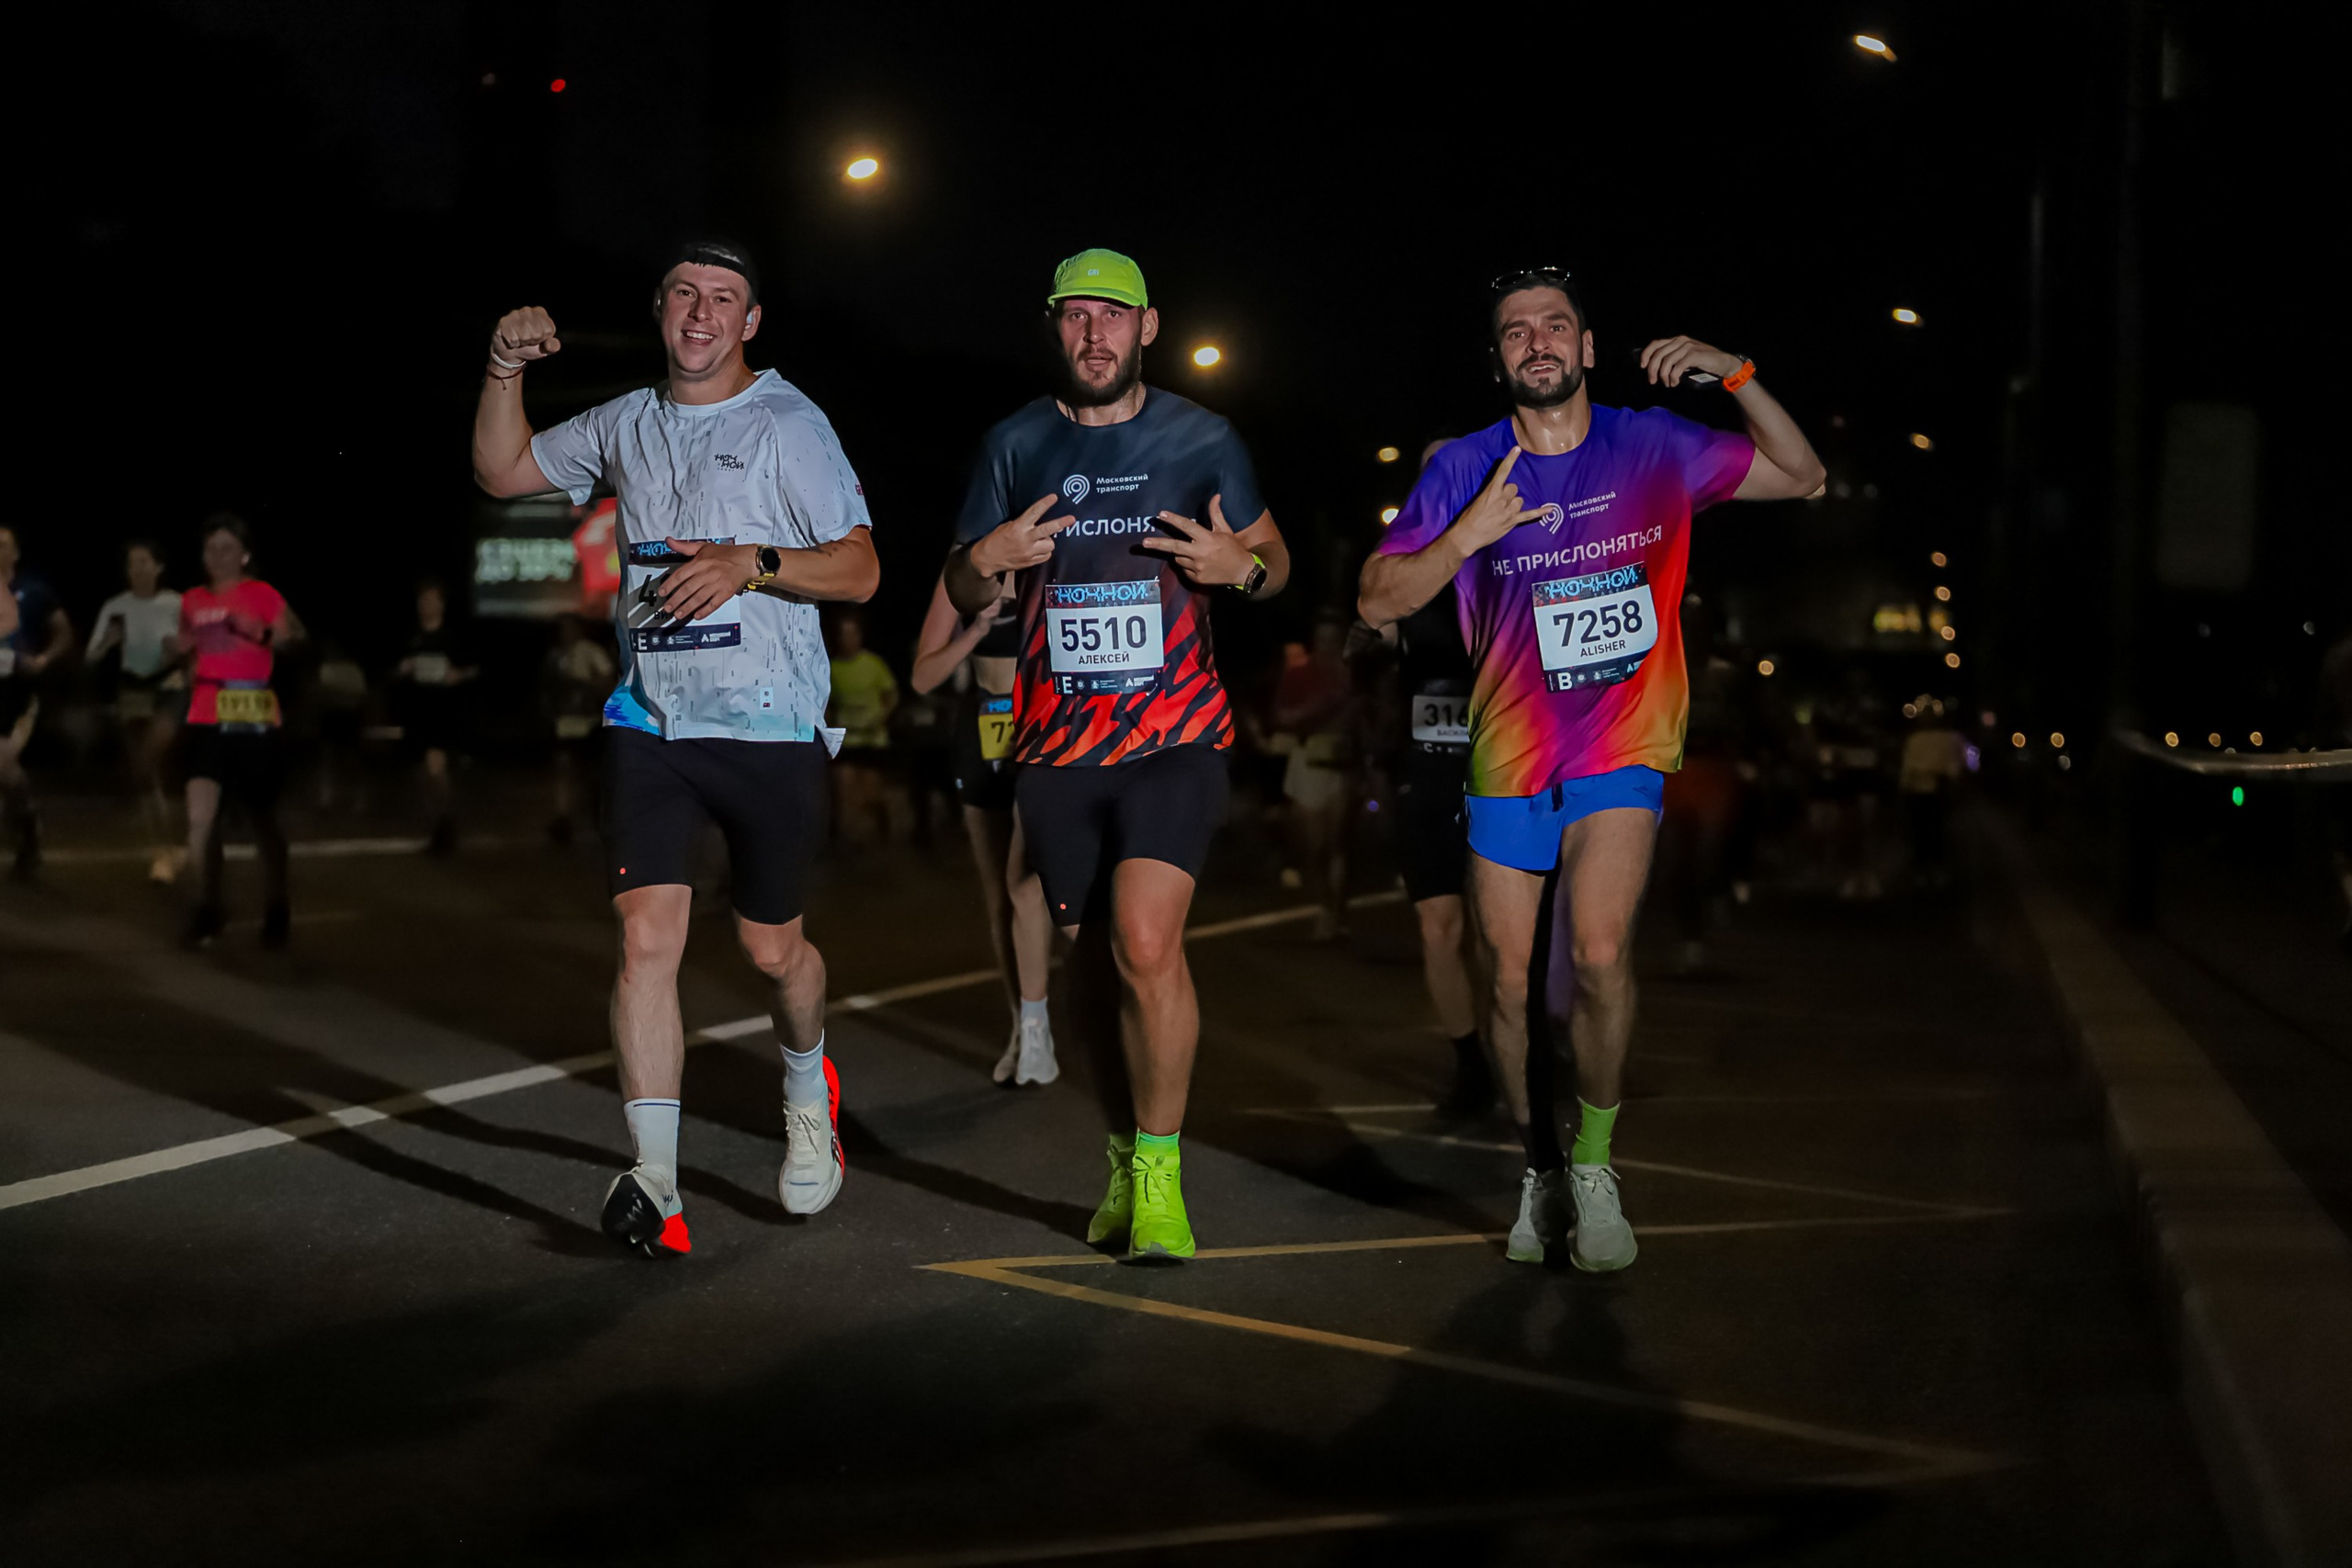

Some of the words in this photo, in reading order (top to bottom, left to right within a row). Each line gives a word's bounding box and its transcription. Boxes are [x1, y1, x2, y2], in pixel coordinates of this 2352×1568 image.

[1096, 473, 1148, 485] Московский
[1096, 483, 1139, 493] транспорт
[1569, 502, 1610, 519] транспорт
[1492, 558, 1514, 576] НЕ
[1517, 525, 1663, 572] ПРИСЛОНЯТЬСЯ
[1544, 565, 1639, 599] НОЧНОЙ
[1055, 582, 1148, 603] НОЧНОЙ
[1060, 615, 1147, 652] 5510
[1553, 600, 1643, 648] 7258
[1078, 650, 1130, 665] АЛЕКСЕЙ
[1580, 639, 1626, 658] ALISHER
[1062, 675, 1073, 694] E
[1557, 671, 1573, 691] B
